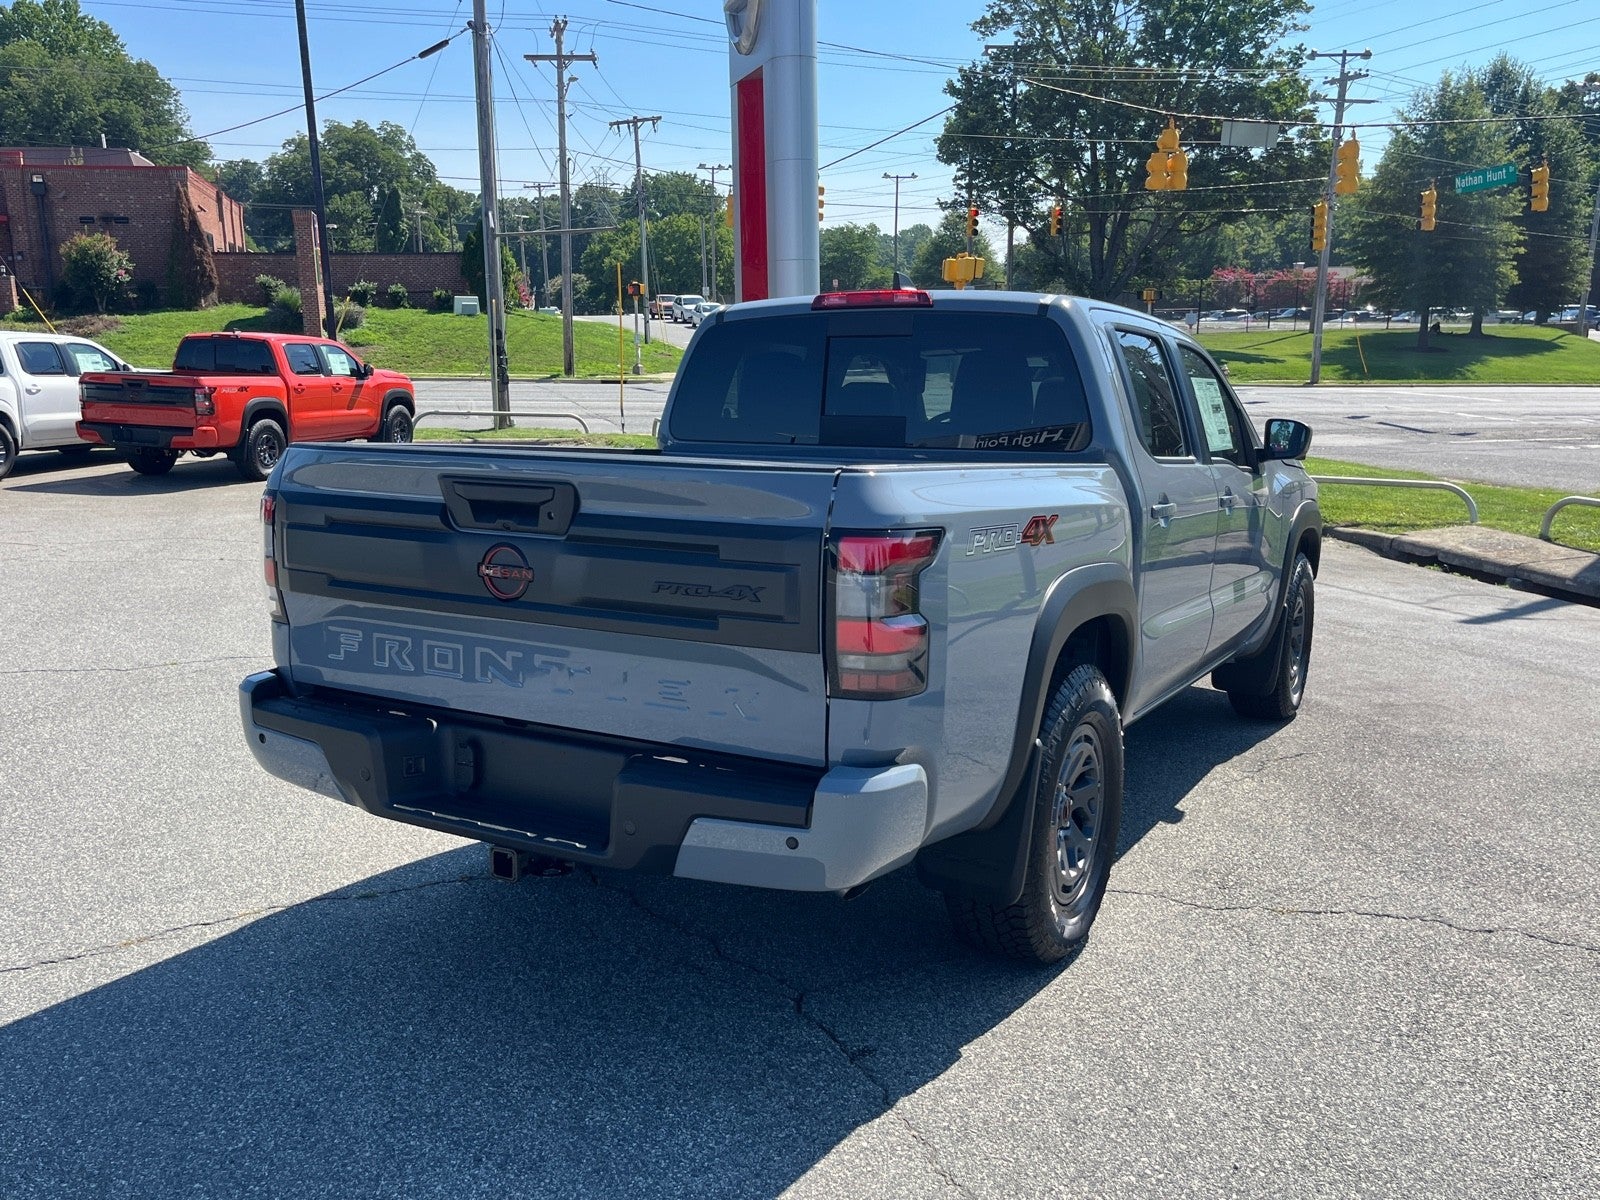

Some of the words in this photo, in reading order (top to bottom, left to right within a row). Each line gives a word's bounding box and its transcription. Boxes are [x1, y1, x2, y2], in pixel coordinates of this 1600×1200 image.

[1455, 175, 1483, 189] Nathan
[1486, 167, 1507, 182] Hunt
[1508, 165, 1515, 173] Dr
